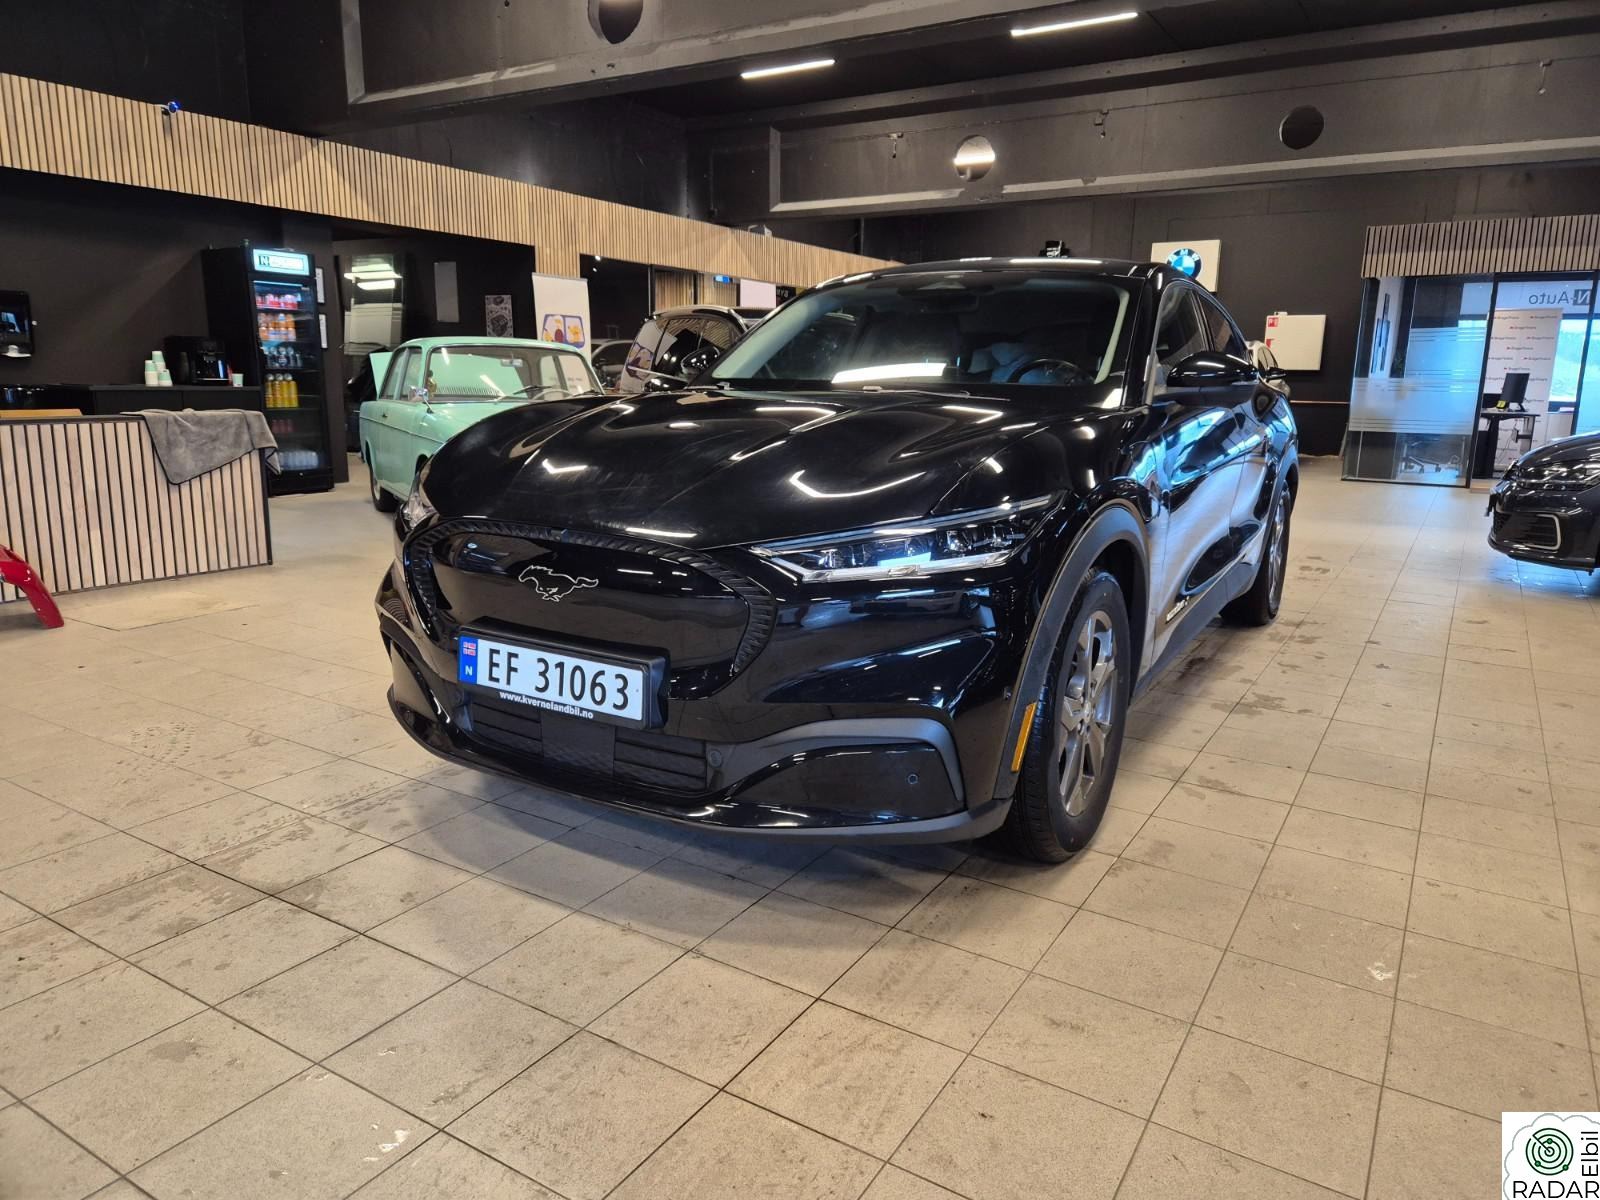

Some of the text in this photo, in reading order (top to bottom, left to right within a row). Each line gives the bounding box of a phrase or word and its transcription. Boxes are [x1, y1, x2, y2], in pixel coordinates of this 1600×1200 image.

[465, 665, 473, 676] N
[488, 648, 630, 711] EF 31063
[499, 690, 594, 720] www.kvernelandbil.no
